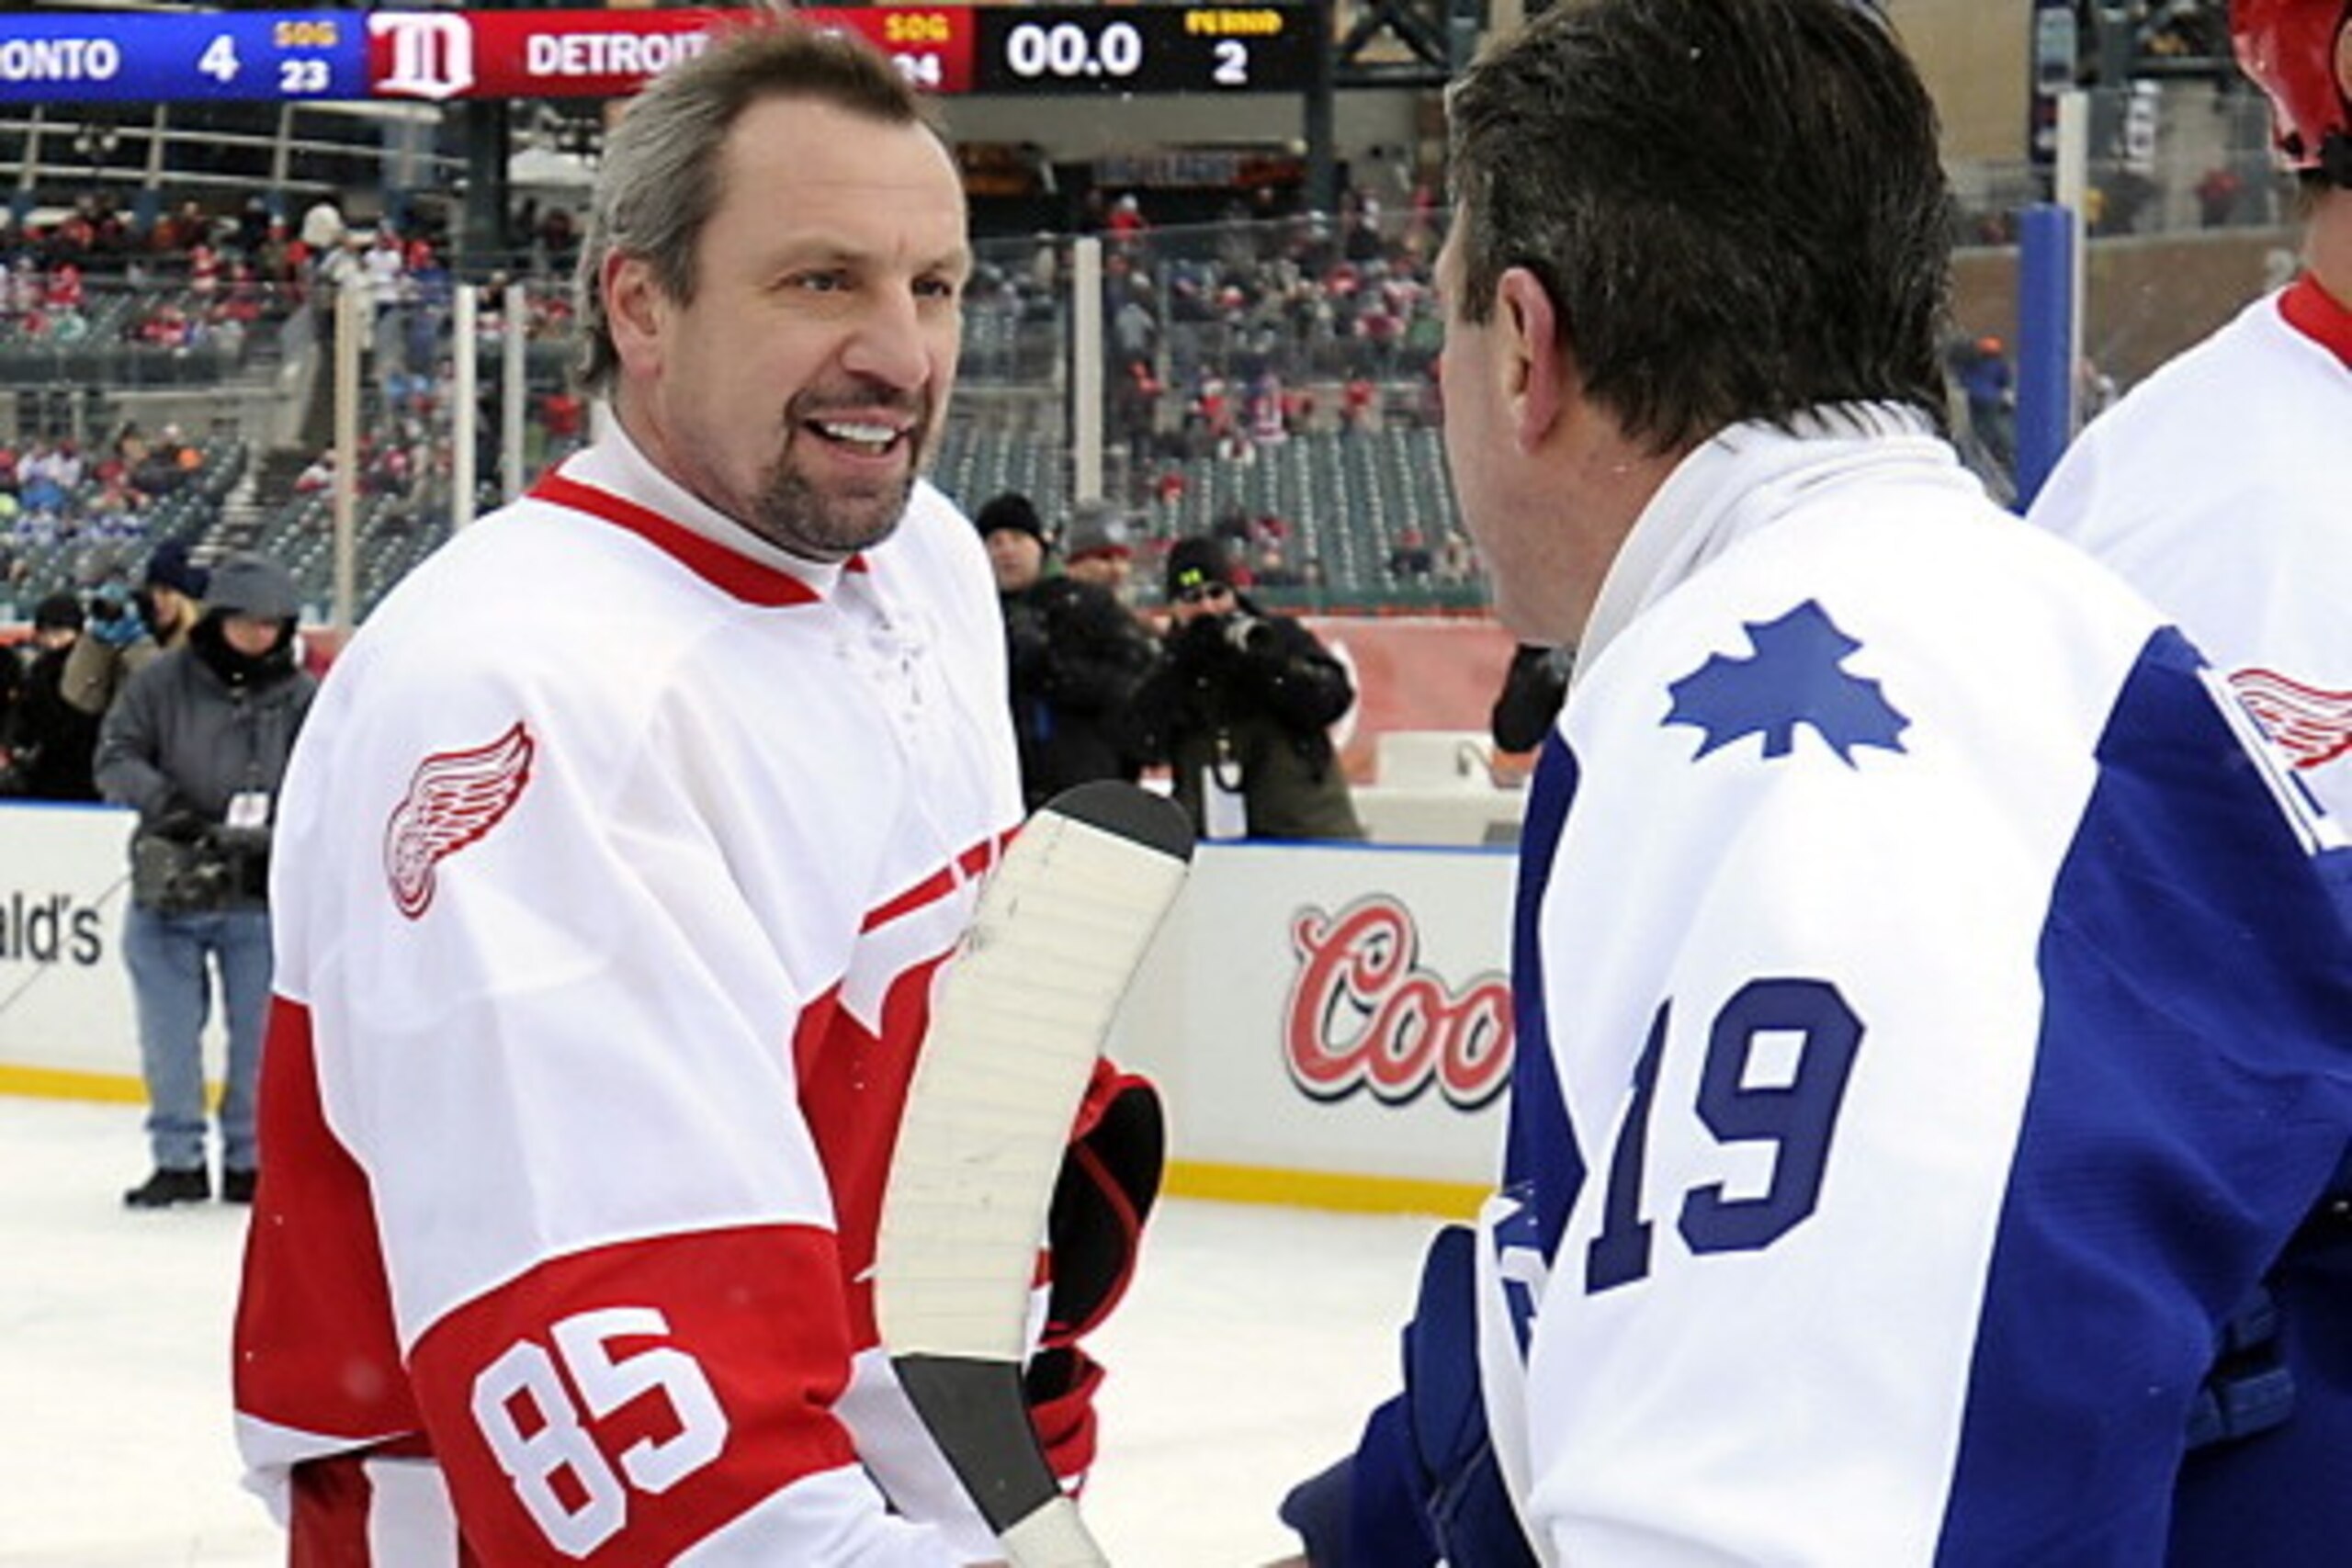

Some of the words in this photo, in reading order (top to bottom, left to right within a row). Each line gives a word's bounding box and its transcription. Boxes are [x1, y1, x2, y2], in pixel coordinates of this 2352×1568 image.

[884, 12, 950, 42] SOG
[1007, 22, 1142, 75] 00.0
[0, 39, 120, 80] ONTO
[198, 34, 240, 81] 4
[279, 60, 330, 91] 23
[1213, 39, 1249, 85] 2
[0, 890, 102, 965] ld's
[1585, 977, 1866, 1296] 19
[469, 1305, 730, 1560] 85
